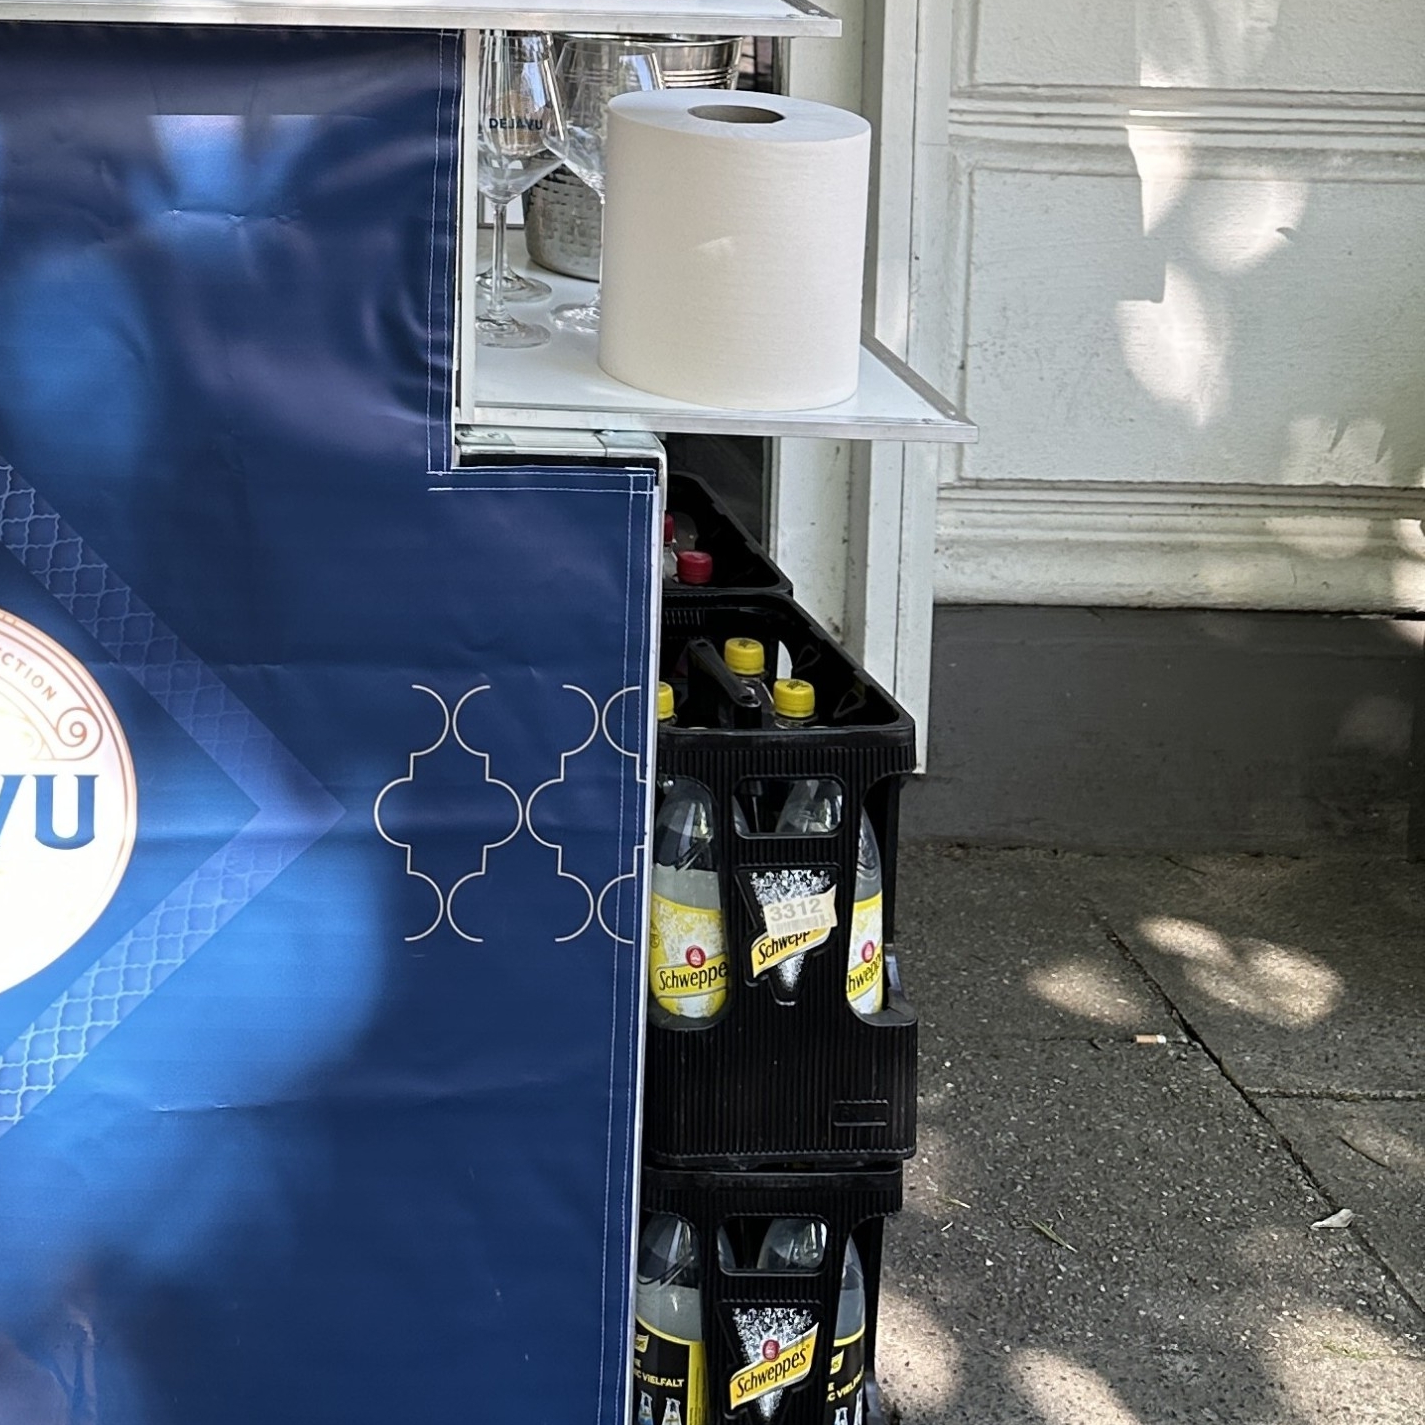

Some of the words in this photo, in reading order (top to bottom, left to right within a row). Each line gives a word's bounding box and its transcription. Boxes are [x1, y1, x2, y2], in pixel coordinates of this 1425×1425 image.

[769, 897, 824, 922] 3312
[757, 927, 818, 966] Schwepp
[642, 1371, 685, 1388] VIELFALT
[735, 1347, 807, 1399] Schweppes
